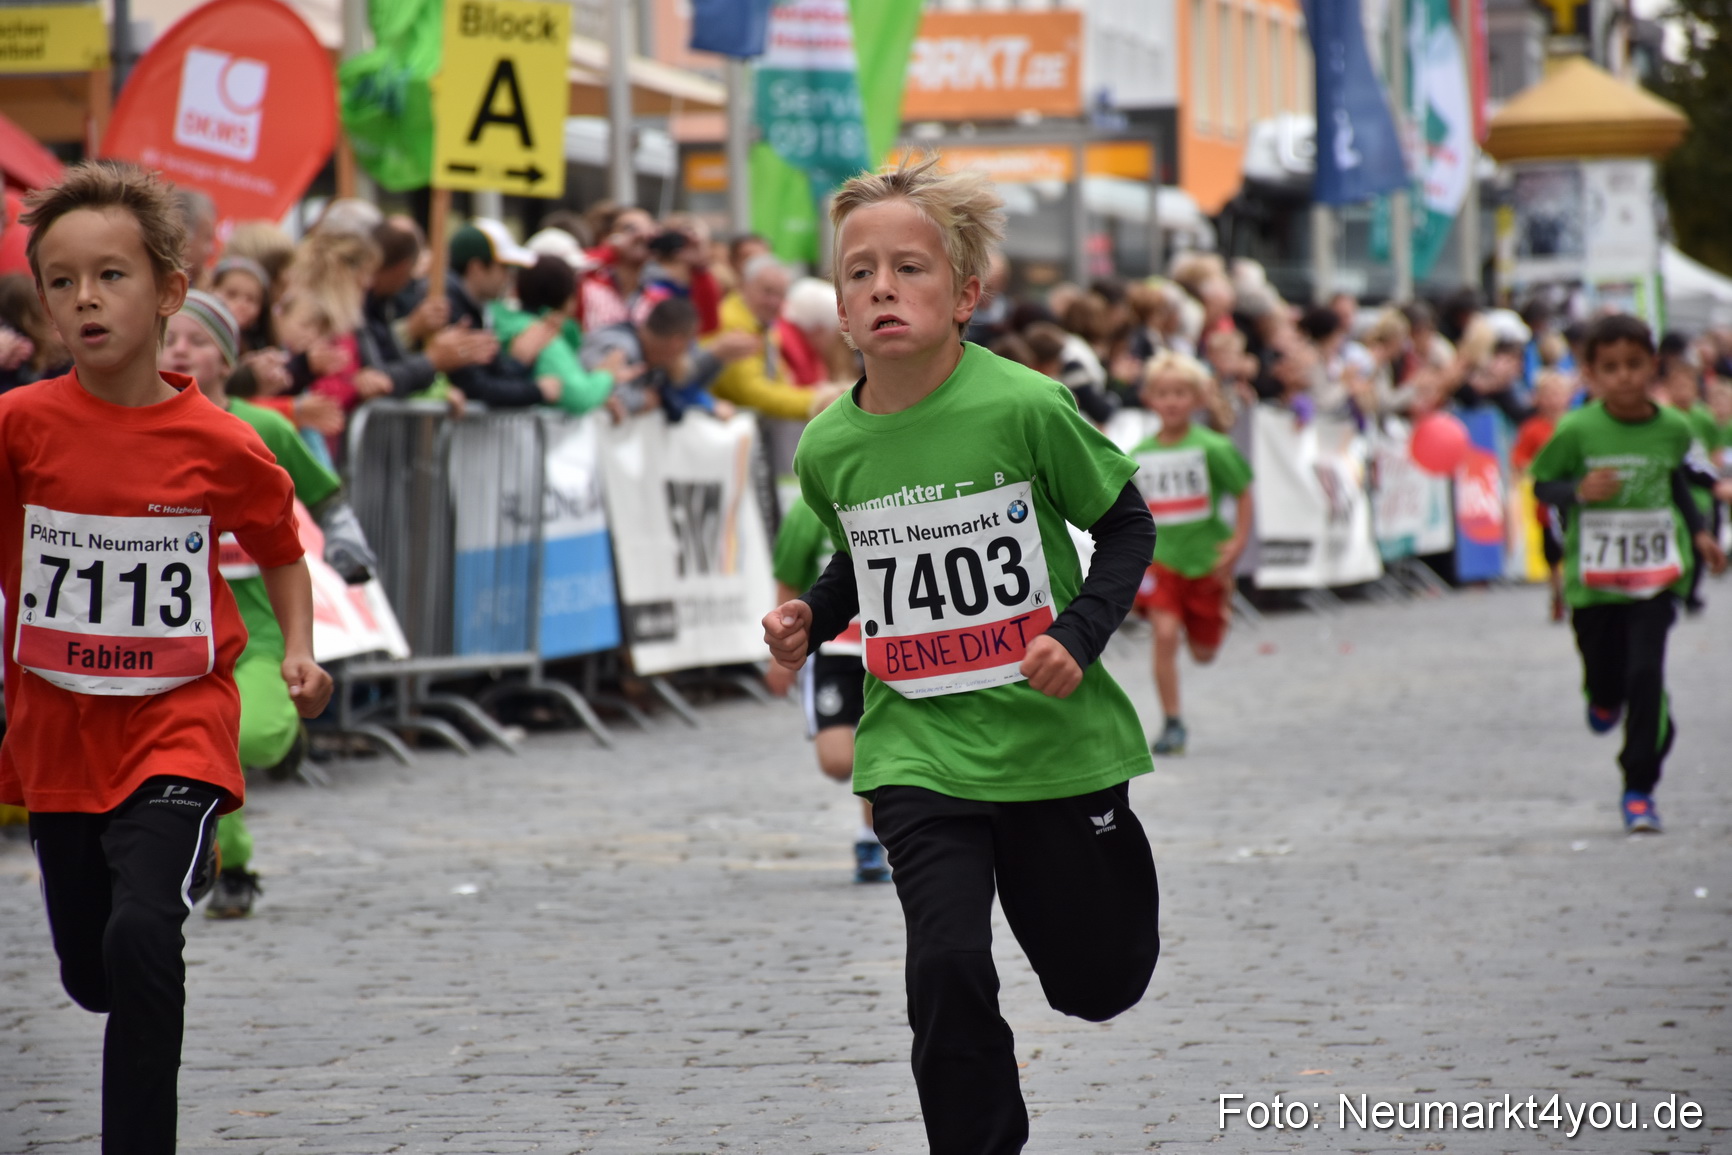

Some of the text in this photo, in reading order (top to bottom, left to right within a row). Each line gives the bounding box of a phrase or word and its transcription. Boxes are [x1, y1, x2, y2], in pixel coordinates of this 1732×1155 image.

[460, 2, 558, 43] Block
[467, 57, 534, 149] A
[148, 504, 161, 512] FC
[30, 524, 83, 548] PARTL
[88, 533, 179, 552] Neumarkt
[851, 512, 1001, 547] PARTL Neumarkt
[1593, 533, 1668, 567] 7159
[40, 554, 192, 628] 7113
[867, 536, 1031, 626] 7403
[26, 611, 33, 623] 4
[67, 641, 154, 670] Fabian
[886, 616, 1031, 674] BENEDIKT
[170, 799, 202, 808] TOUCH
